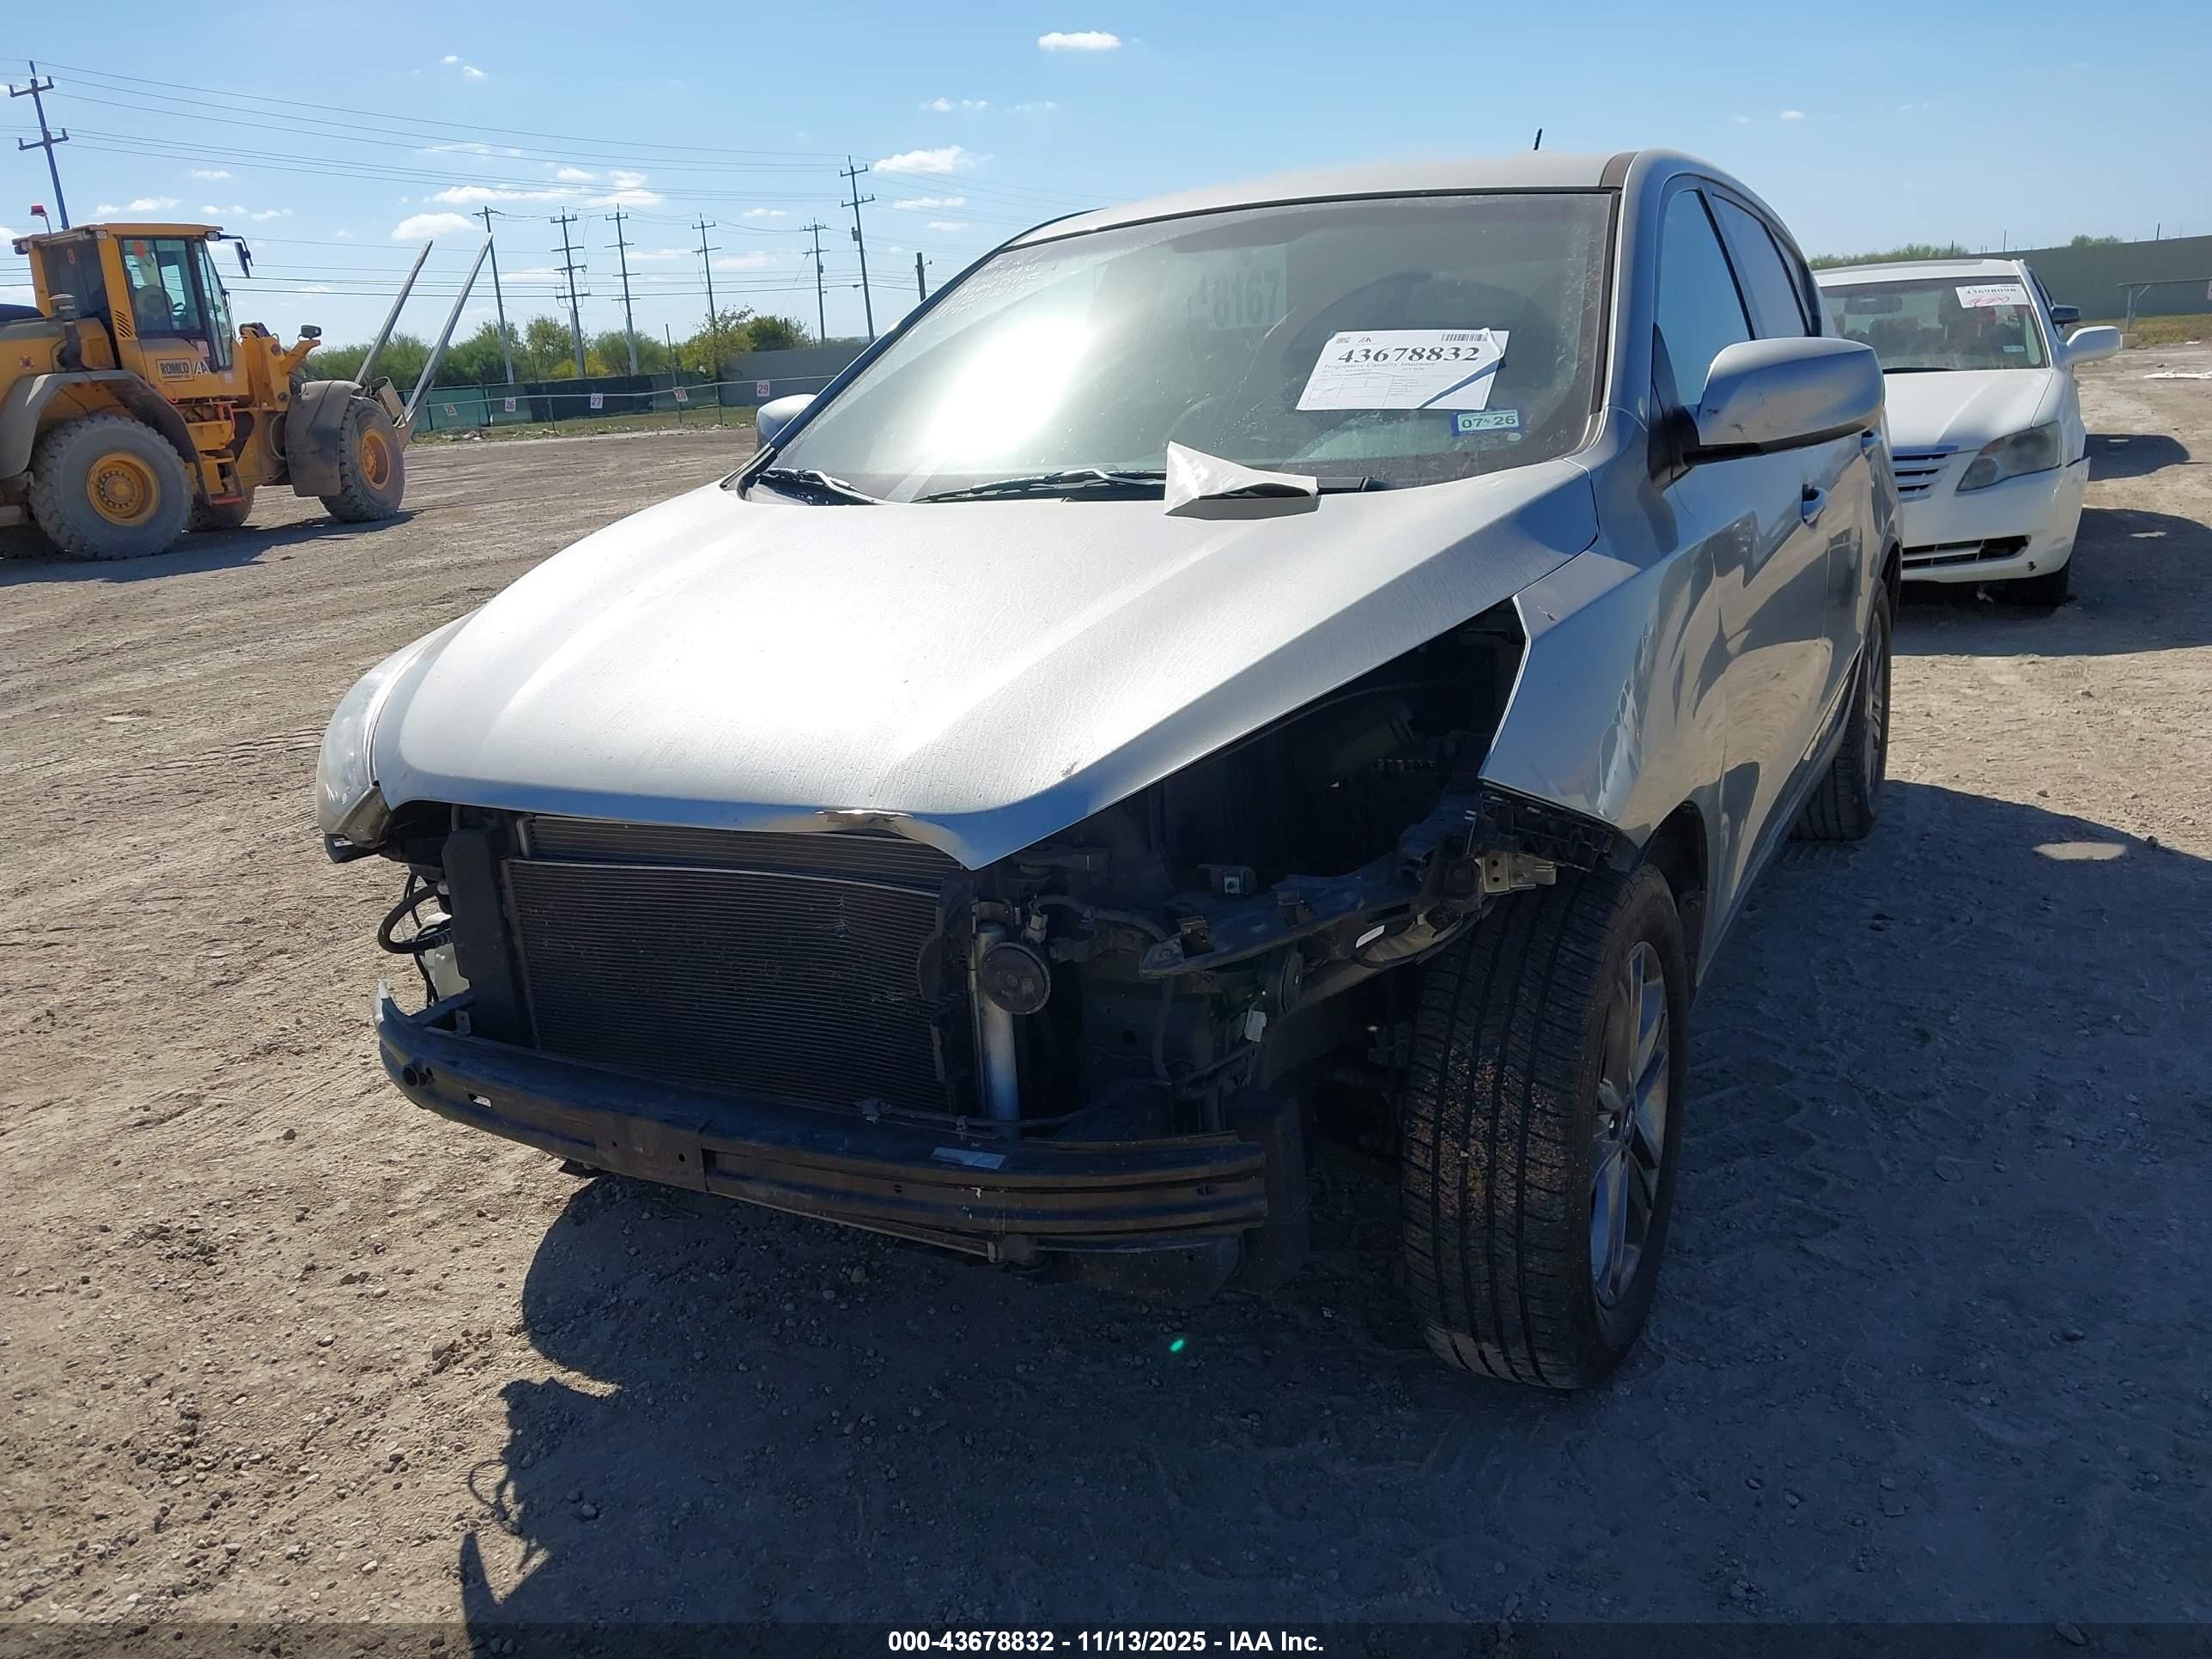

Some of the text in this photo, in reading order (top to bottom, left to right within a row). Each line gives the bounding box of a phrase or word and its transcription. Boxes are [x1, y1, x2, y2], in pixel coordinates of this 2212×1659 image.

[1337, 346, 1480, 363] 43678832
[160, 362, 190, 375] ROMCO
[676, 390, 686, 399] 28
[757, 384, 769, 394] 29
[506, 399, 515, 410] 26
[591, 397, 601, 406] 27
[1462, 415, 1516, 428] 07 26
